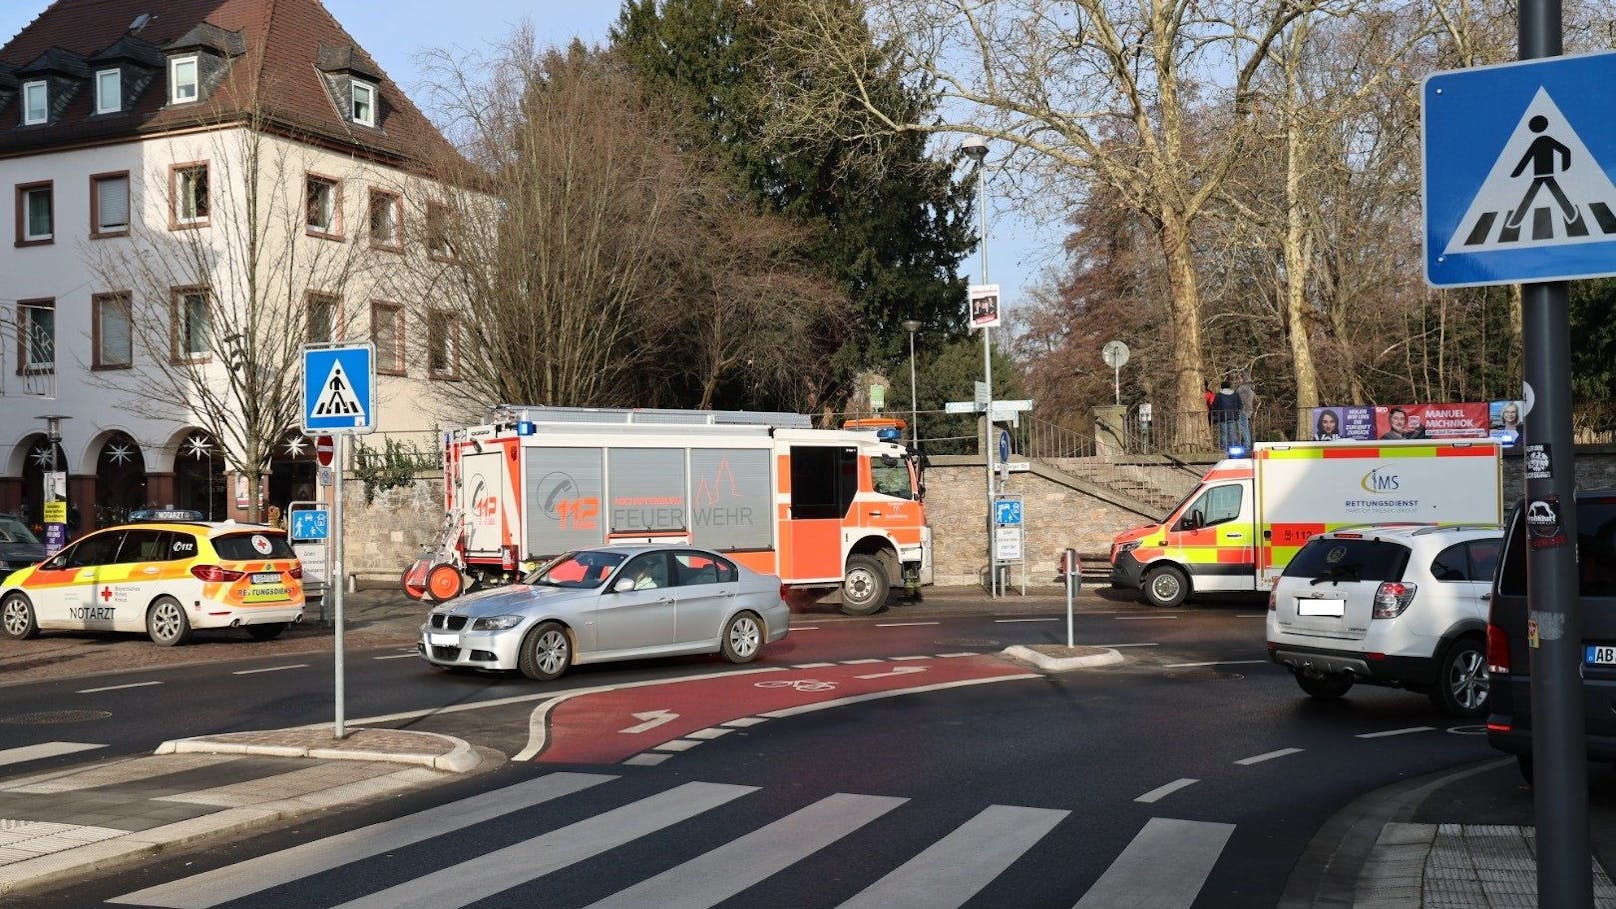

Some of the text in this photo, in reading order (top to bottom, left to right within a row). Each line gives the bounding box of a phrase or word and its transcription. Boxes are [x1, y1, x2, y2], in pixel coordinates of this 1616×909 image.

[1425, 409, 1465, 418] MANUEL
[1425, 418, 1474, 428] MICHNIOK
[158, 511, 184, 519] NOTARZT
[555, 497, 600, 531] 112
[1295, 531, 1312, 540] 112
[181, 543, 194, 551] 112
[69, 607, 116, 620] NOTARZT
[1596, 648, 1613, 662] AB
